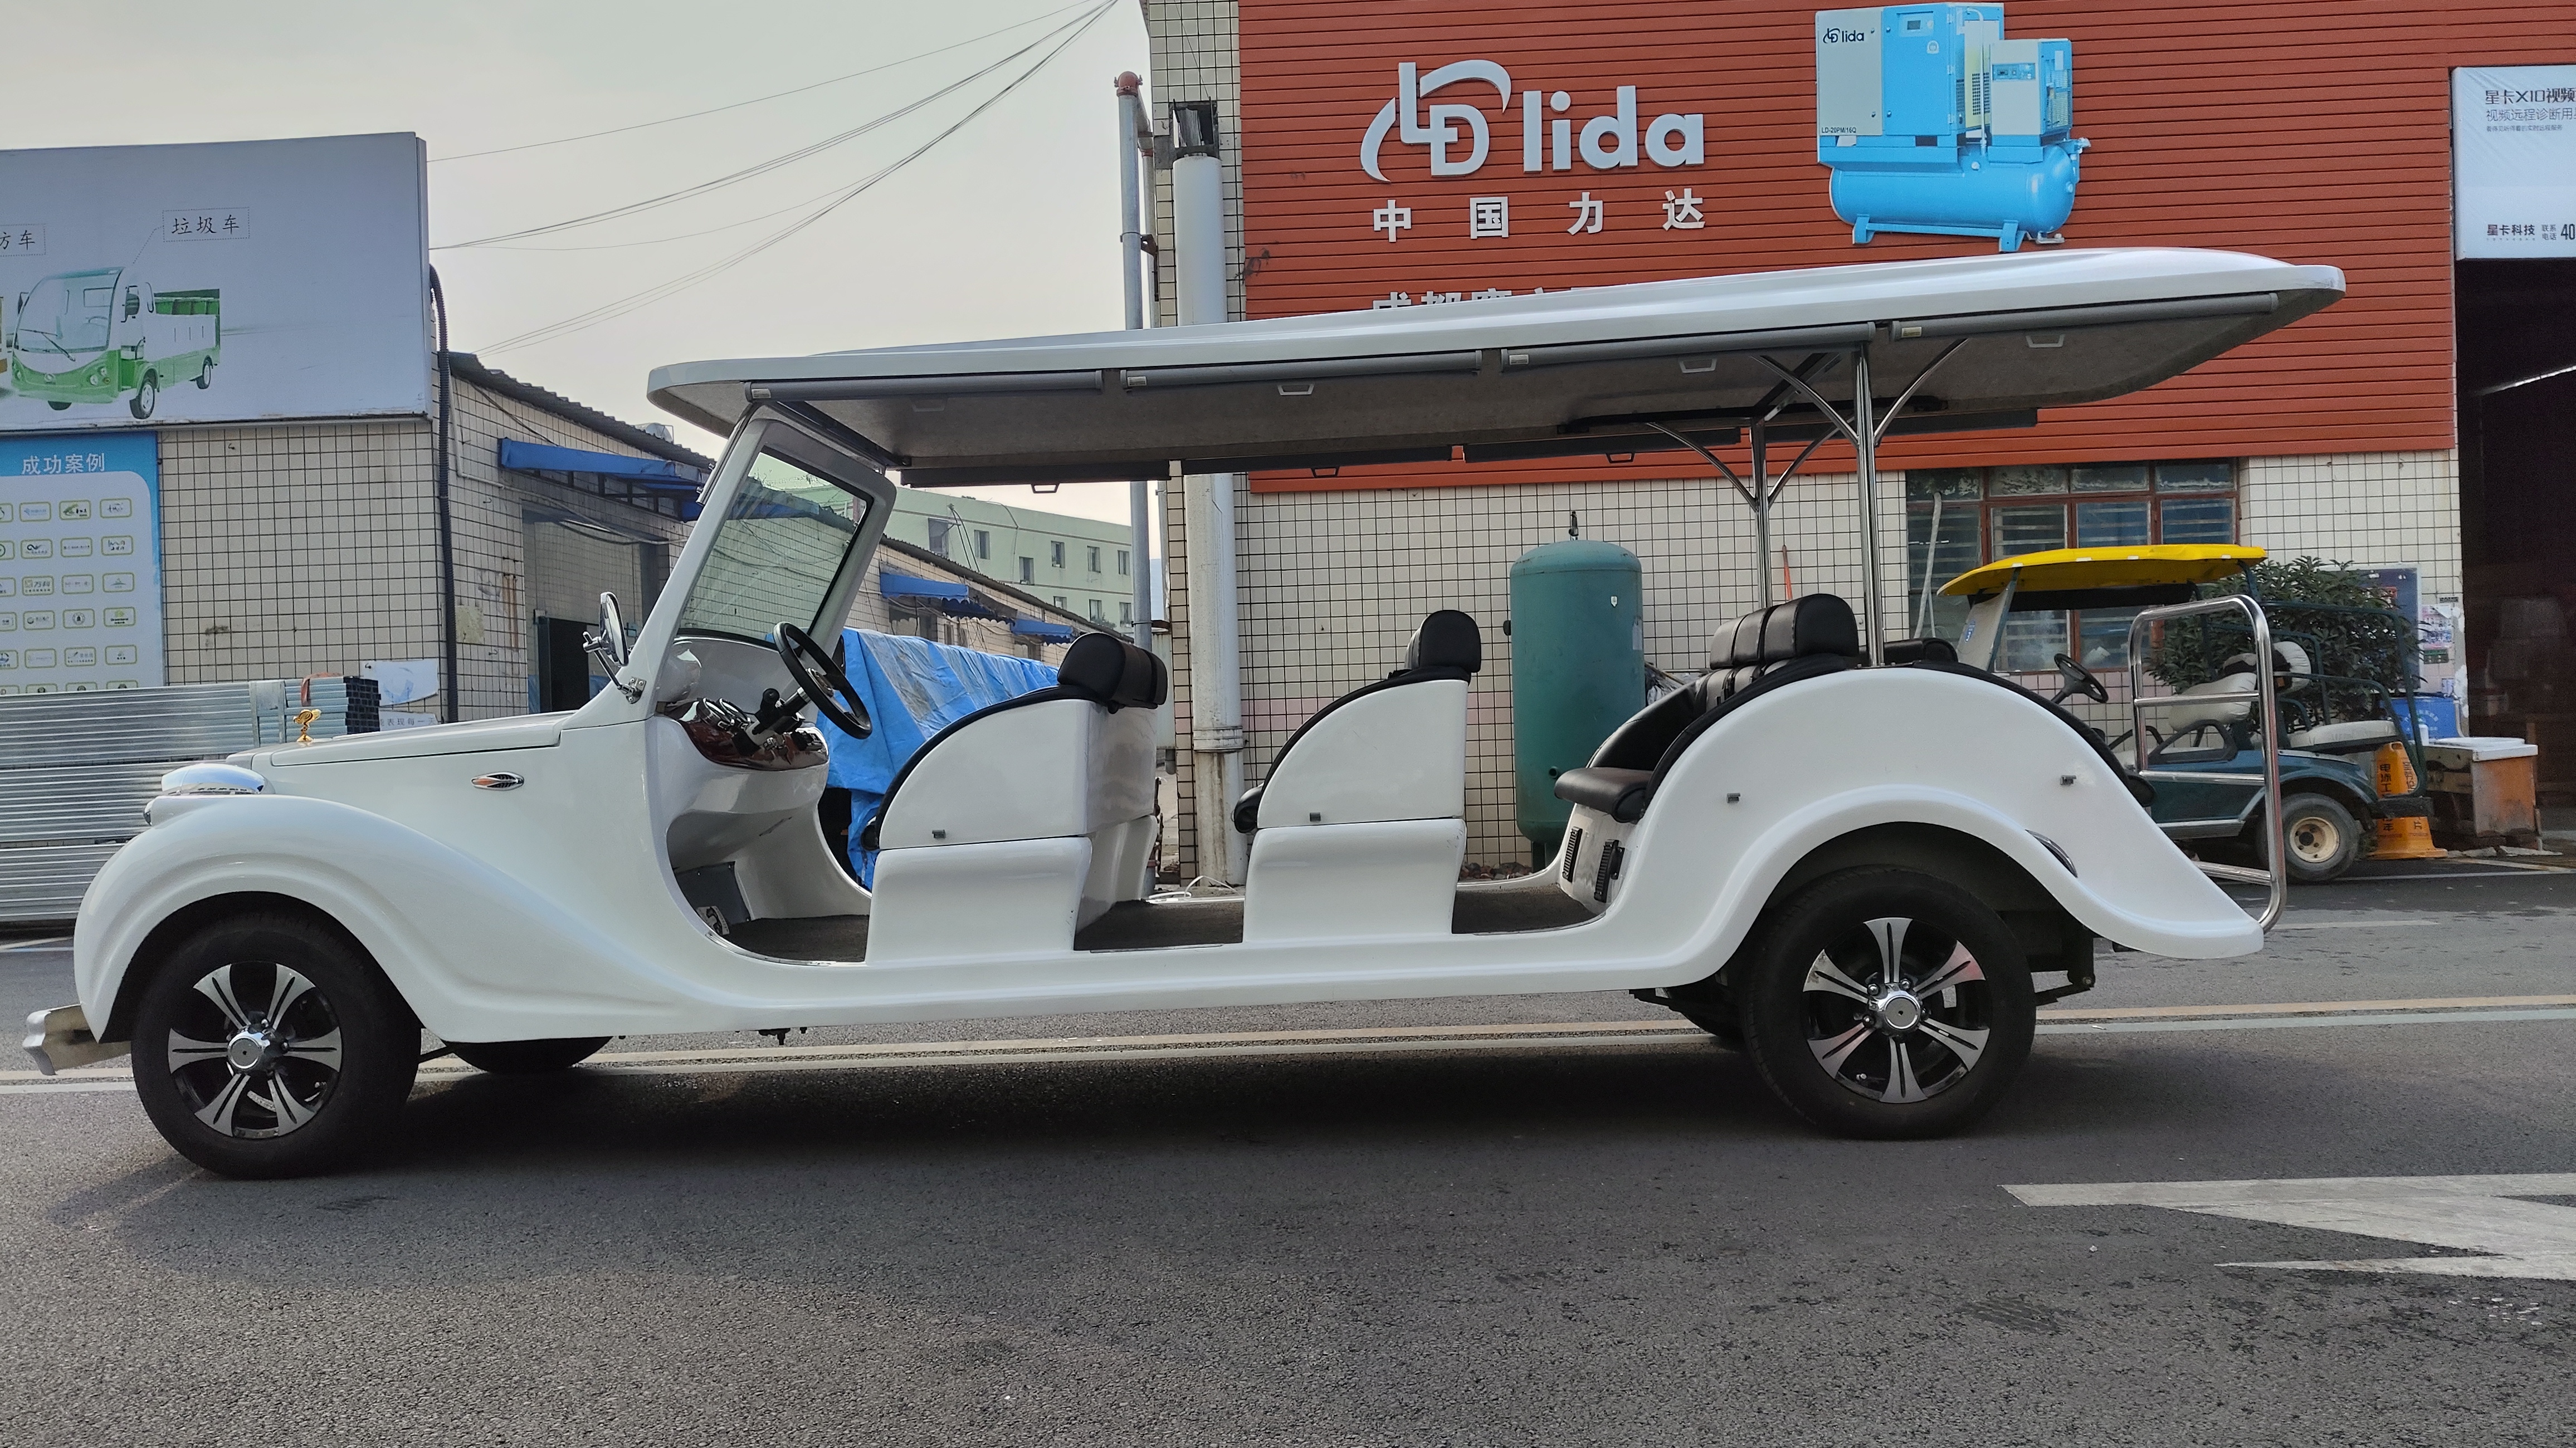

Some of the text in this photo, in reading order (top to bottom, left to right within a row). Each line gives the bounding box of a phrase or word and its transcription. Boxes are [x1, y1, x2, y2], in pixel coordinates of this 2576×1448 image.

[1842, 30, 1865, 42] lida
[2485, 87, 2576, 105] 星卡X10视频
[2486, 107, 2576, 121] 视频远程诊断用
[1523, 85, 1705, 174] lida
[172, 214, 240, 234] 垃圾车
[1373, 188, 1706, 243] 中国力达
[2487, 224, 2535, 236] 星卡科技
[22, 452, 105, 474] 成功案例
